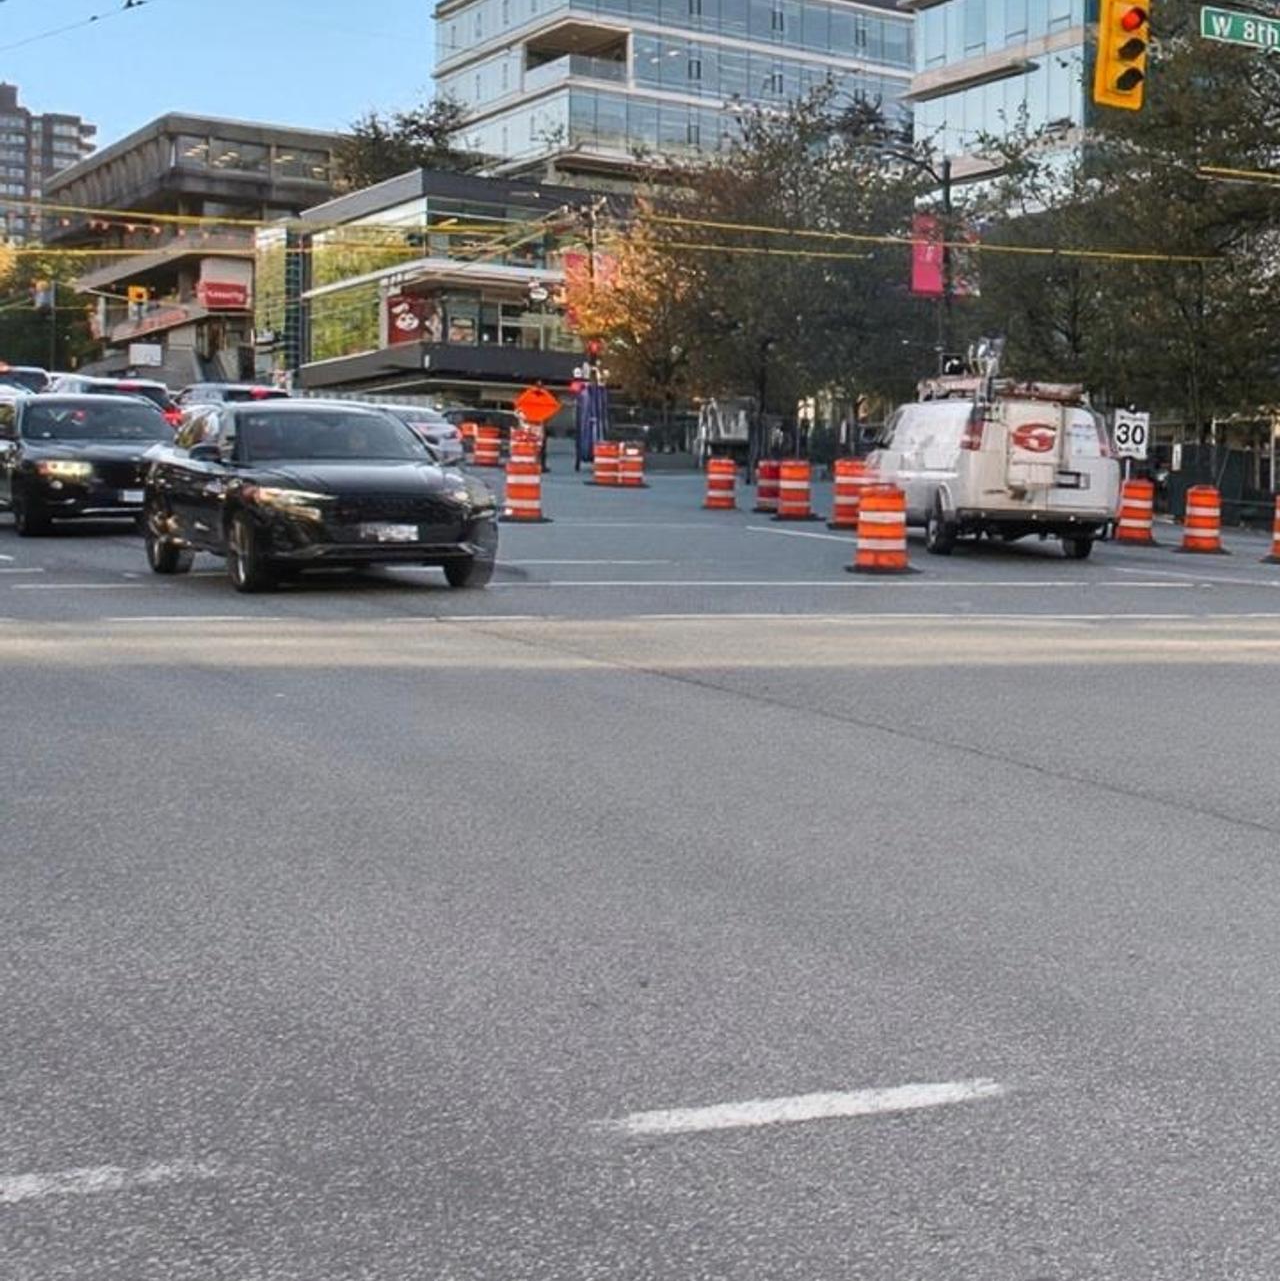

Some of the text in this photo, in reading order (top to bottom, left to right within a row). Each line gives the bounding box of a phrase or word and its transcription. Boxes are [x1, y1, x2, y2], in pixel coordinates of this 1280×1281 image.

[1211, 15, 1233, 37] W
[1243, 20, 1279, 46] 8th
[1116, 423, 1145, 445] 30
